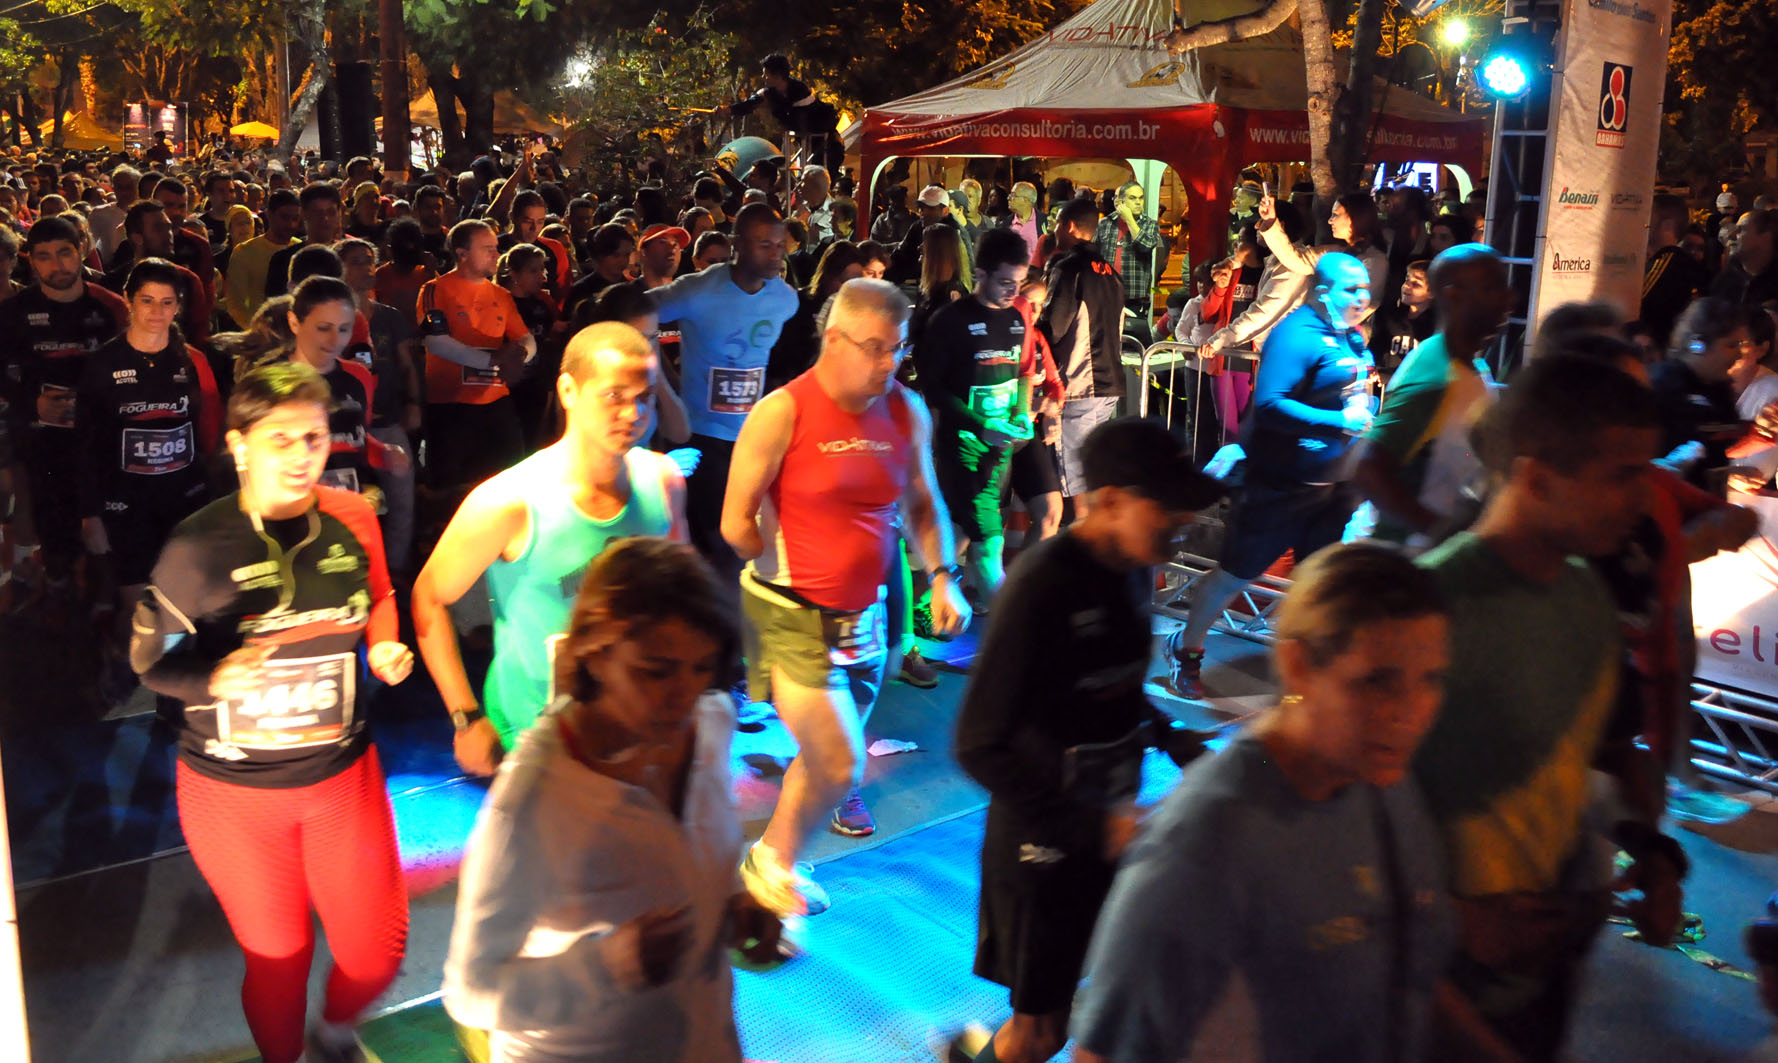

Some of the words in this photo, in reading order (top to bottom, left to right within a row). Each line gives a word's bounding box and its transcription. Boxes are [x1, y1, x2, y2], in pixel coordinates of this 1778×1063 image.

[1552, 252, 1591, 271] America
[119, 402, 177, 414] FOGUEIRA
[133, 438, 187, 457] 1508
